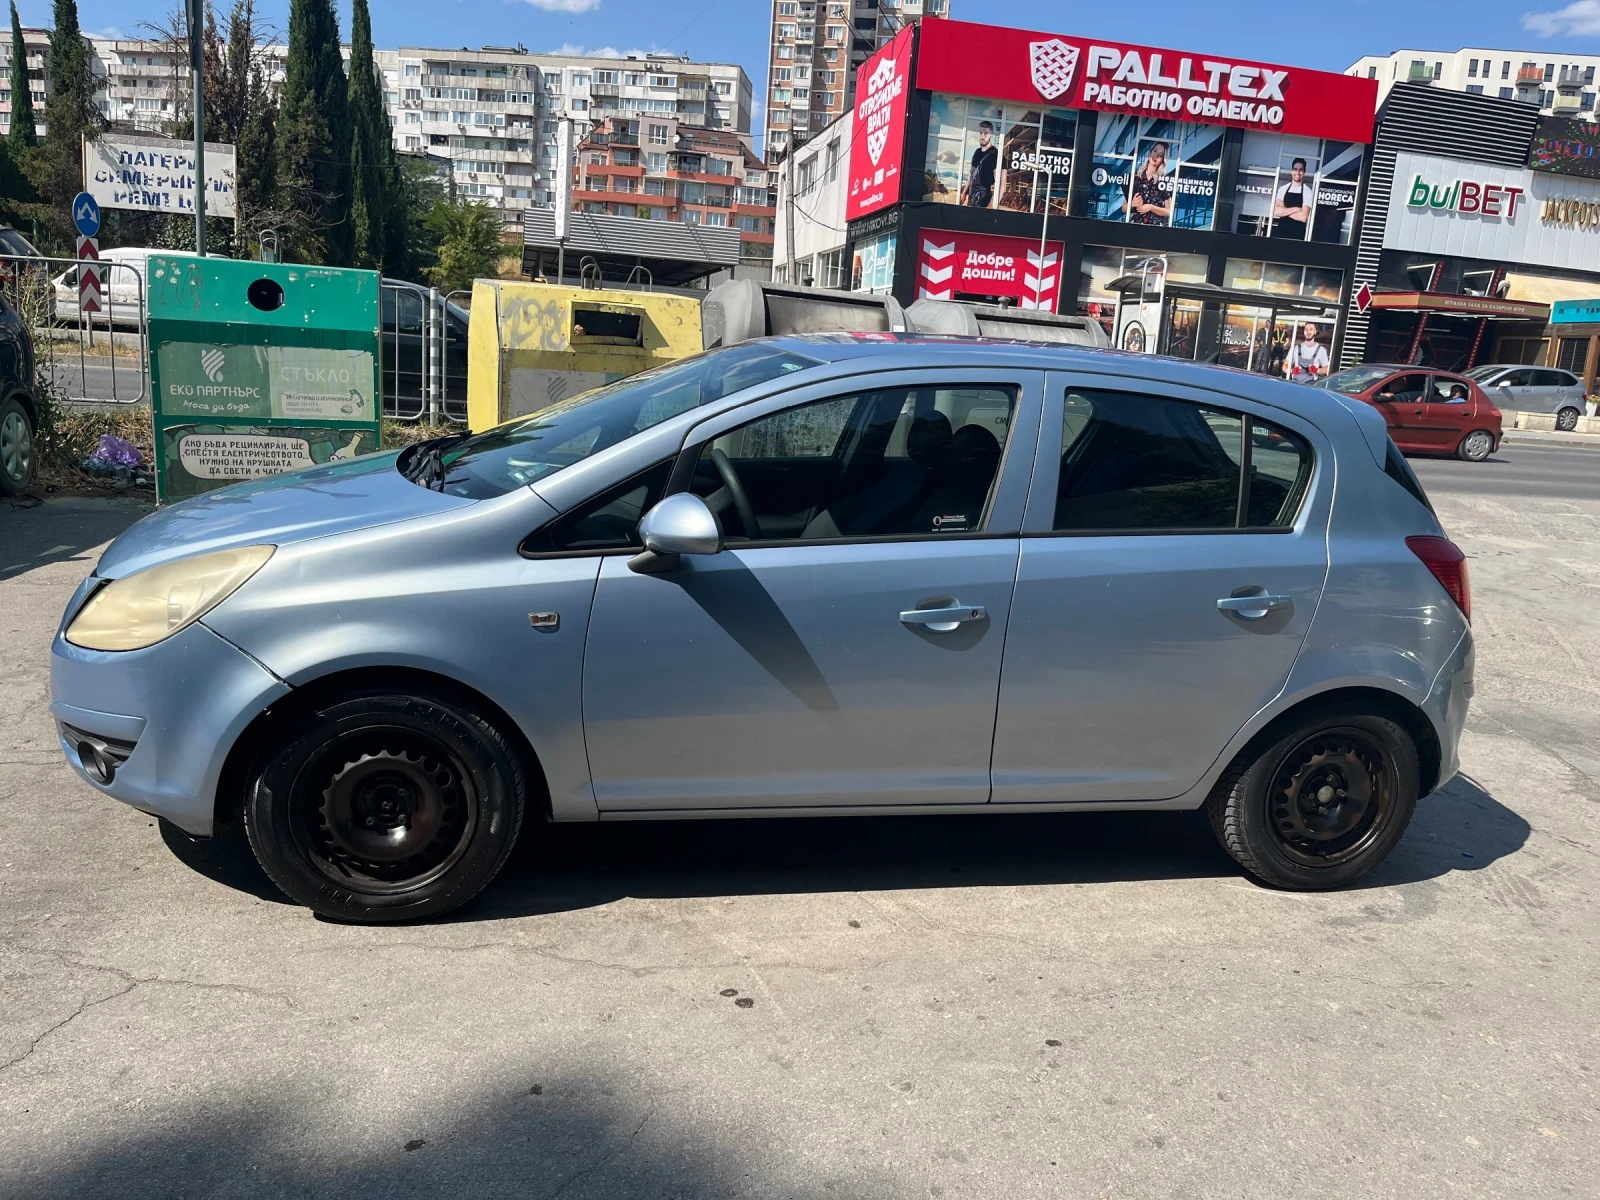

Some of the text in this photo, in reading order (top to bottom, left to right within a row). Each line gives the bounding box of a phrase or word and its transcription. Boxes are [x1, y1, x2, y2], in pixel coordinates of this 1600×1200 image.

[1086, 45, 1288, 101] PALLTEX
[859, 74, 902, 120] ОТВОРИХМЕ
[1084, 82, 1284, 125] РАБОТНО ОБЛЕКЛО
[867, 103, 891, 134] ВРАТИ
[1012, 151, 1070, 166] РАБОТНО
[1158, 181, 1214, 196] ОБЛЕКЛО
[1236, 185, 1273, 195] PALLTEX
[1408, 174, 1525, 218] bulBET
[1318, 192, 1354, 203] HORECA
[1541, 197, 1600, 227] JACKPOTS
[966, 250, 1014, 269] Добре
[962, 267, 1016, 281] дошли!
[281, 367, 350, 383] СТЪКЛО
[170, 384, 260, 398] ЕКО ПАРТНЪРС
[183, 400, 209, 410] Мога
[212, 404, 225, 413] да
[184, 440, 304, 451] АКО БЪДА РЕЦИКЛИРАН, ЩЕ
[184, 448, 219, 457] СПЕСТЯ
[199, 458, 229, 466] НУЖНО
[246, 459, 292, 467] КРУШКАТА
[209, 467, 221, 475] ДА
[224, 467, 252, 475] СВЕТИ
